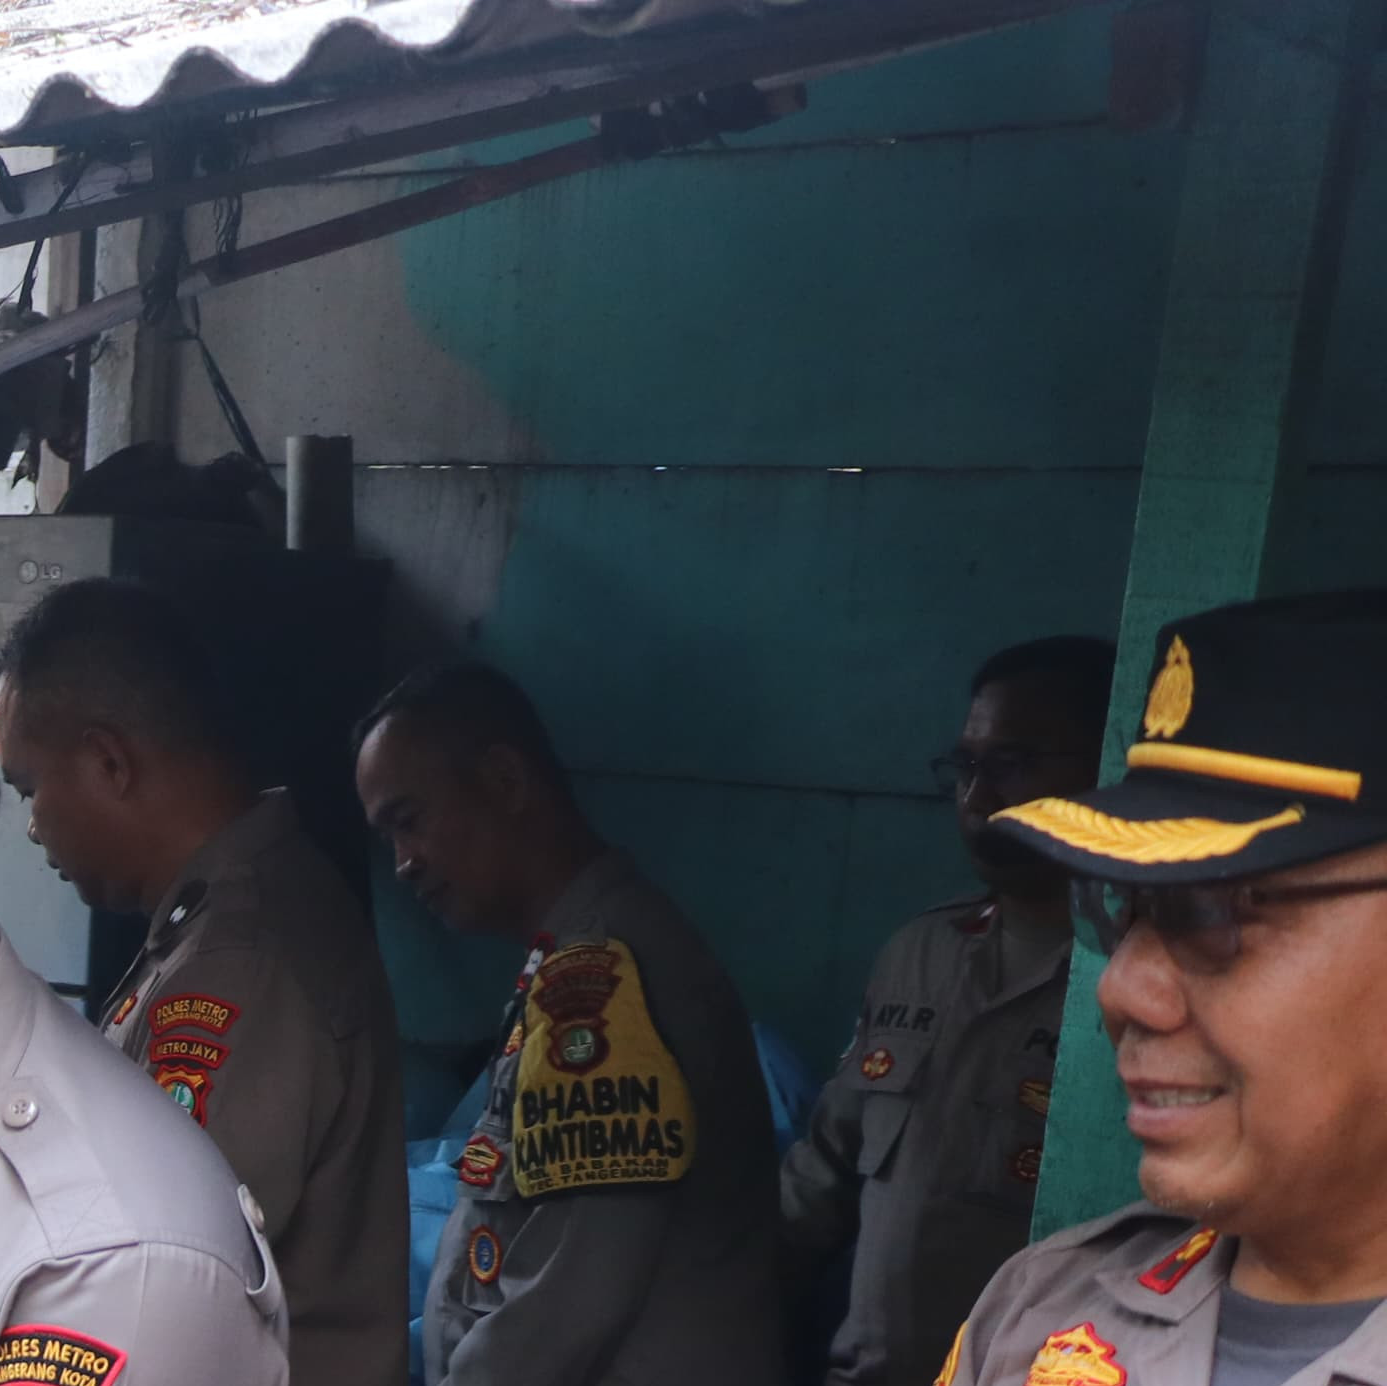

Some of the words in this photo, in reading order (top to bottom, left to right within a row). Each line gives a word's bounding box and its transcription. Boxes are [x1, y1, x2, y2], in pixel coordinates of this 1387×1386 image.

[40, 563, 62, 580] LG
[156, 999, 191, 1020] POLRES
[192, 999, 228, 1021] METRO
[155, 1042, 188, 1055] METRO
[189, 1043, 219, 1062] JAYA
[521, 1076, 659, 1129] BHABIN
[515, 1118, 684, 1175] KAMTIBMAS
[560, 1158, 669, 1175] BABAKAN
[561, 1167, 668, 1183] TANGERANG
[43, 1340, 109, 1375] METRO
